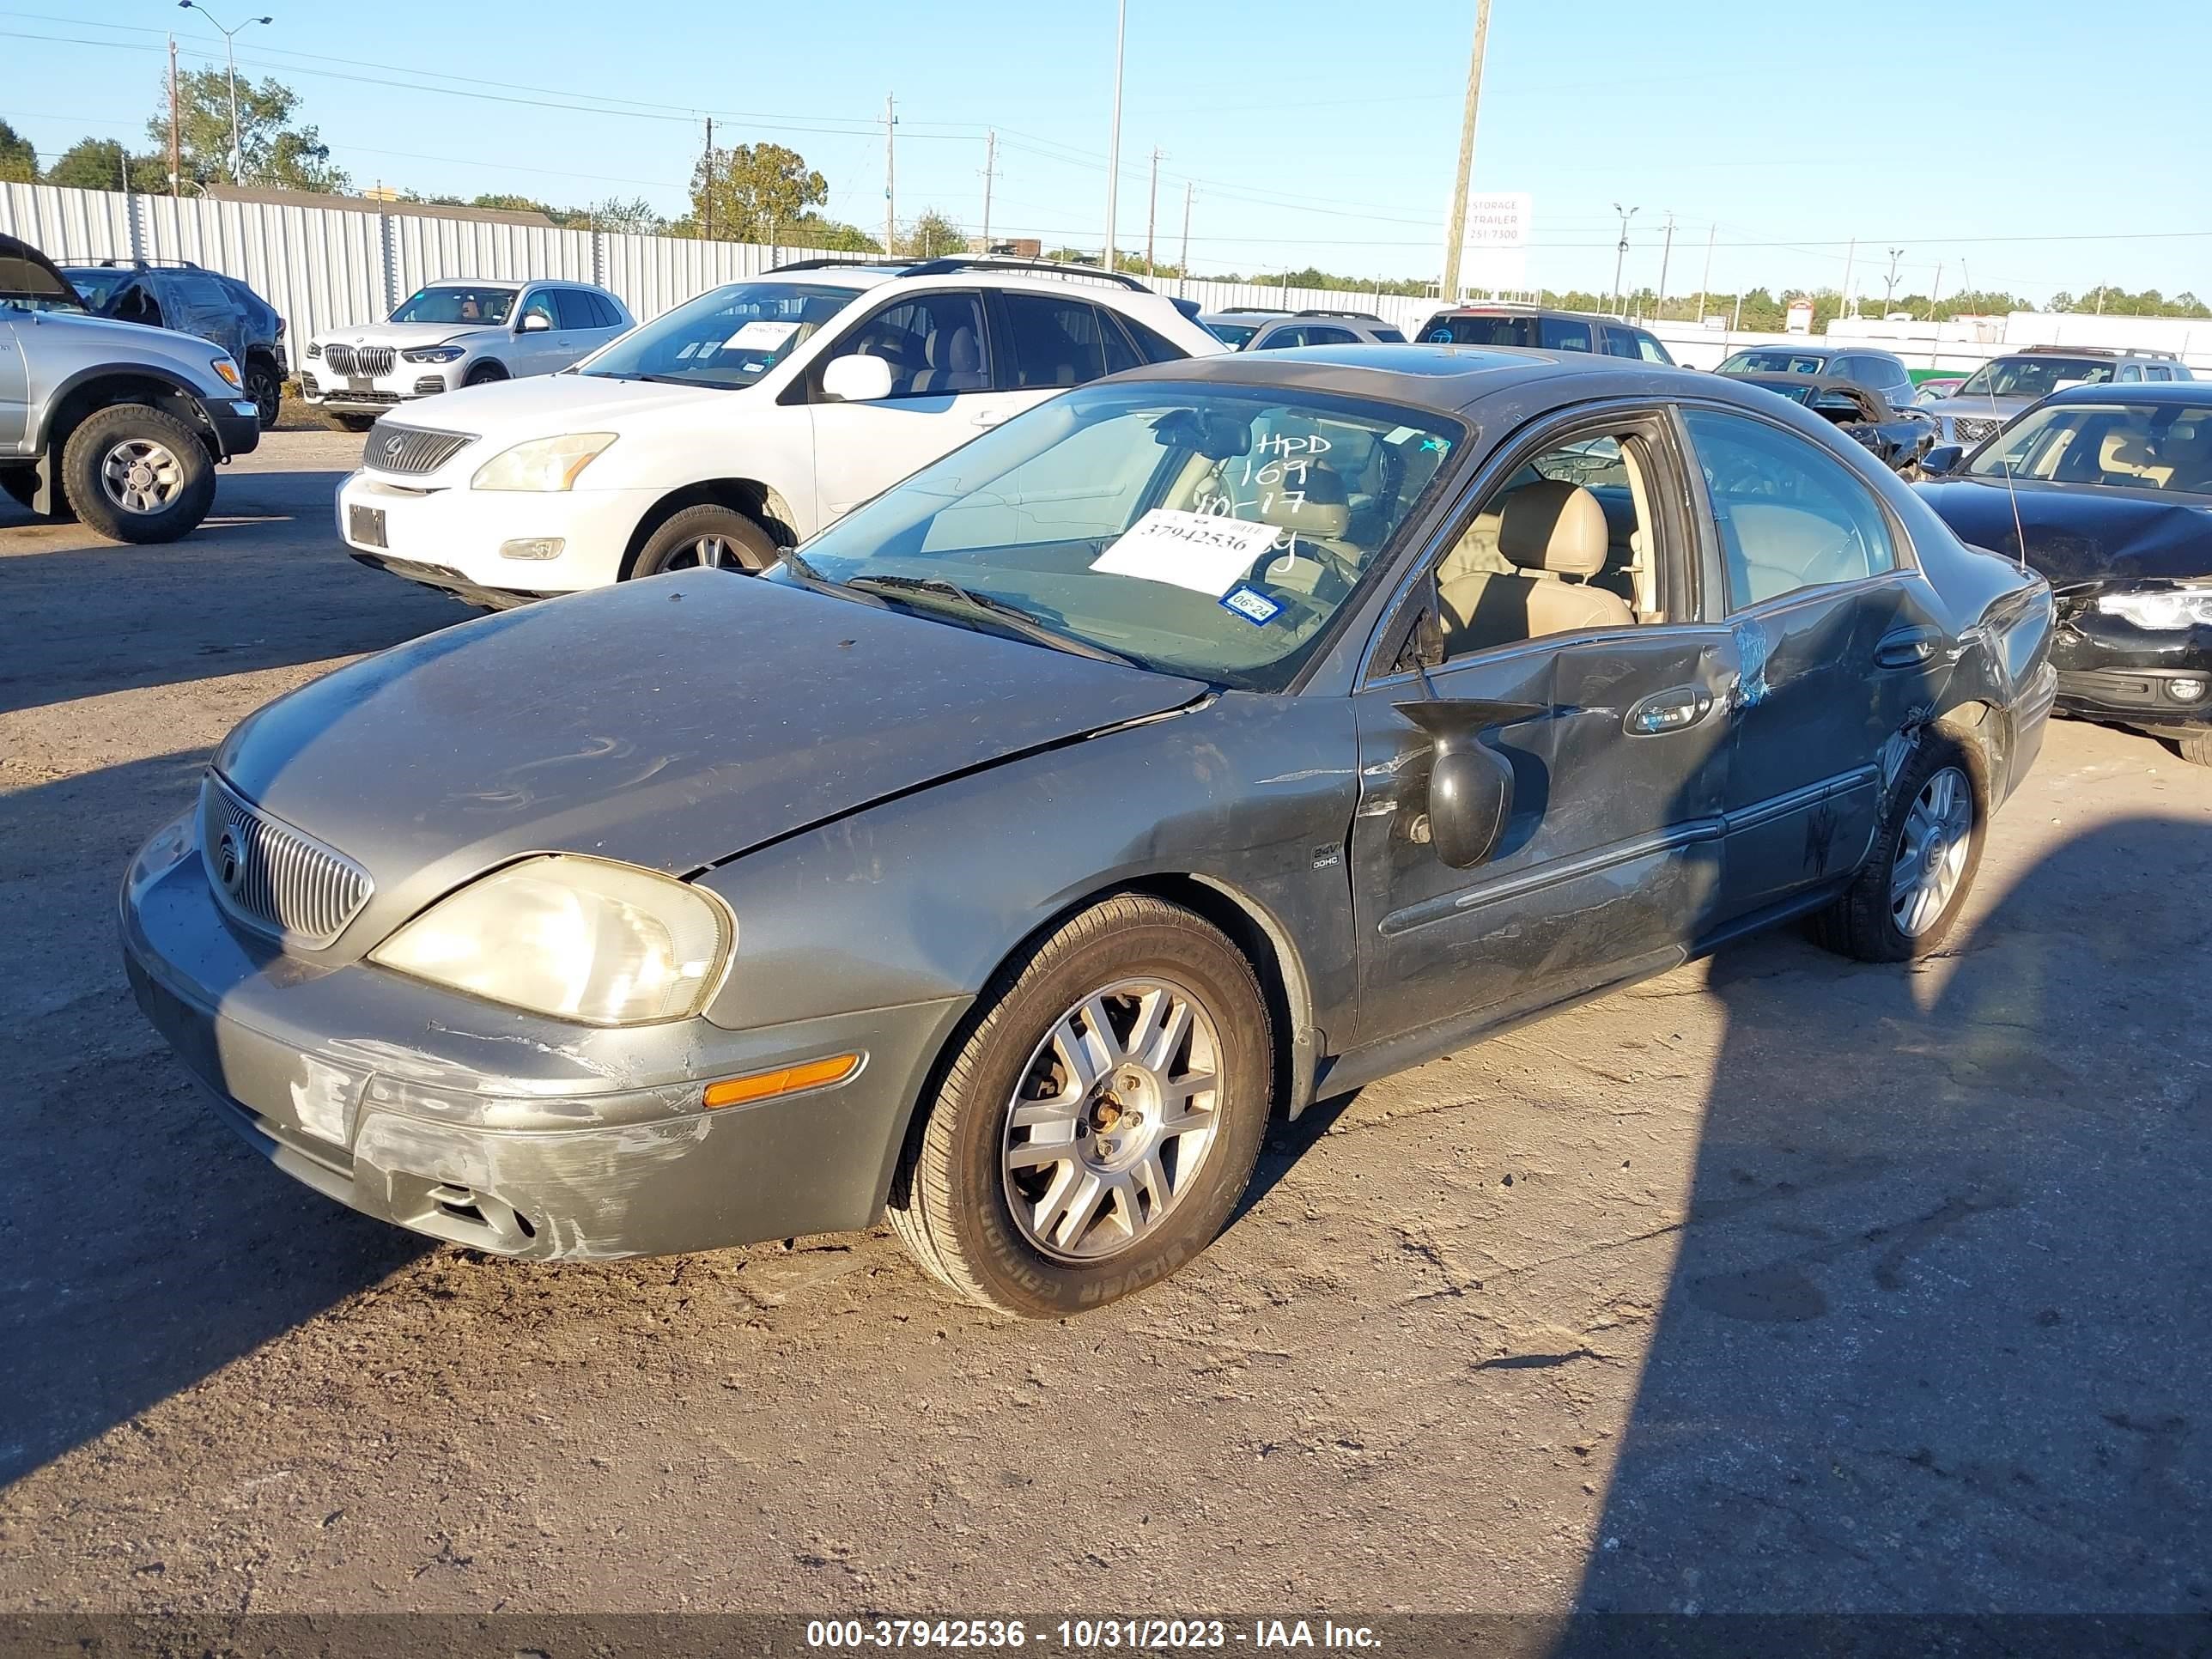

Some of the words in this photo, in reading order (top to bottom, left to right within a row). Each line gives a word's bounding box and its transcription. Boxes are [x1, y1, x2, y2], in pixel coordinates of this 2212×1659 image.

[1473, 201, 1517, 210] STORAGE
[1474, 216, 1518, 225] TRAILER
[1255, 433, 1332, 458] HPD
[1240, 459, 1309, 487] 169
[1194, 490, 1306, 519] 10-17
[1140, 524, 1248, 551] 37942536
[1313, 842, 1340, 859] 24V
[1312, 856, 1339, 869] DOHC
